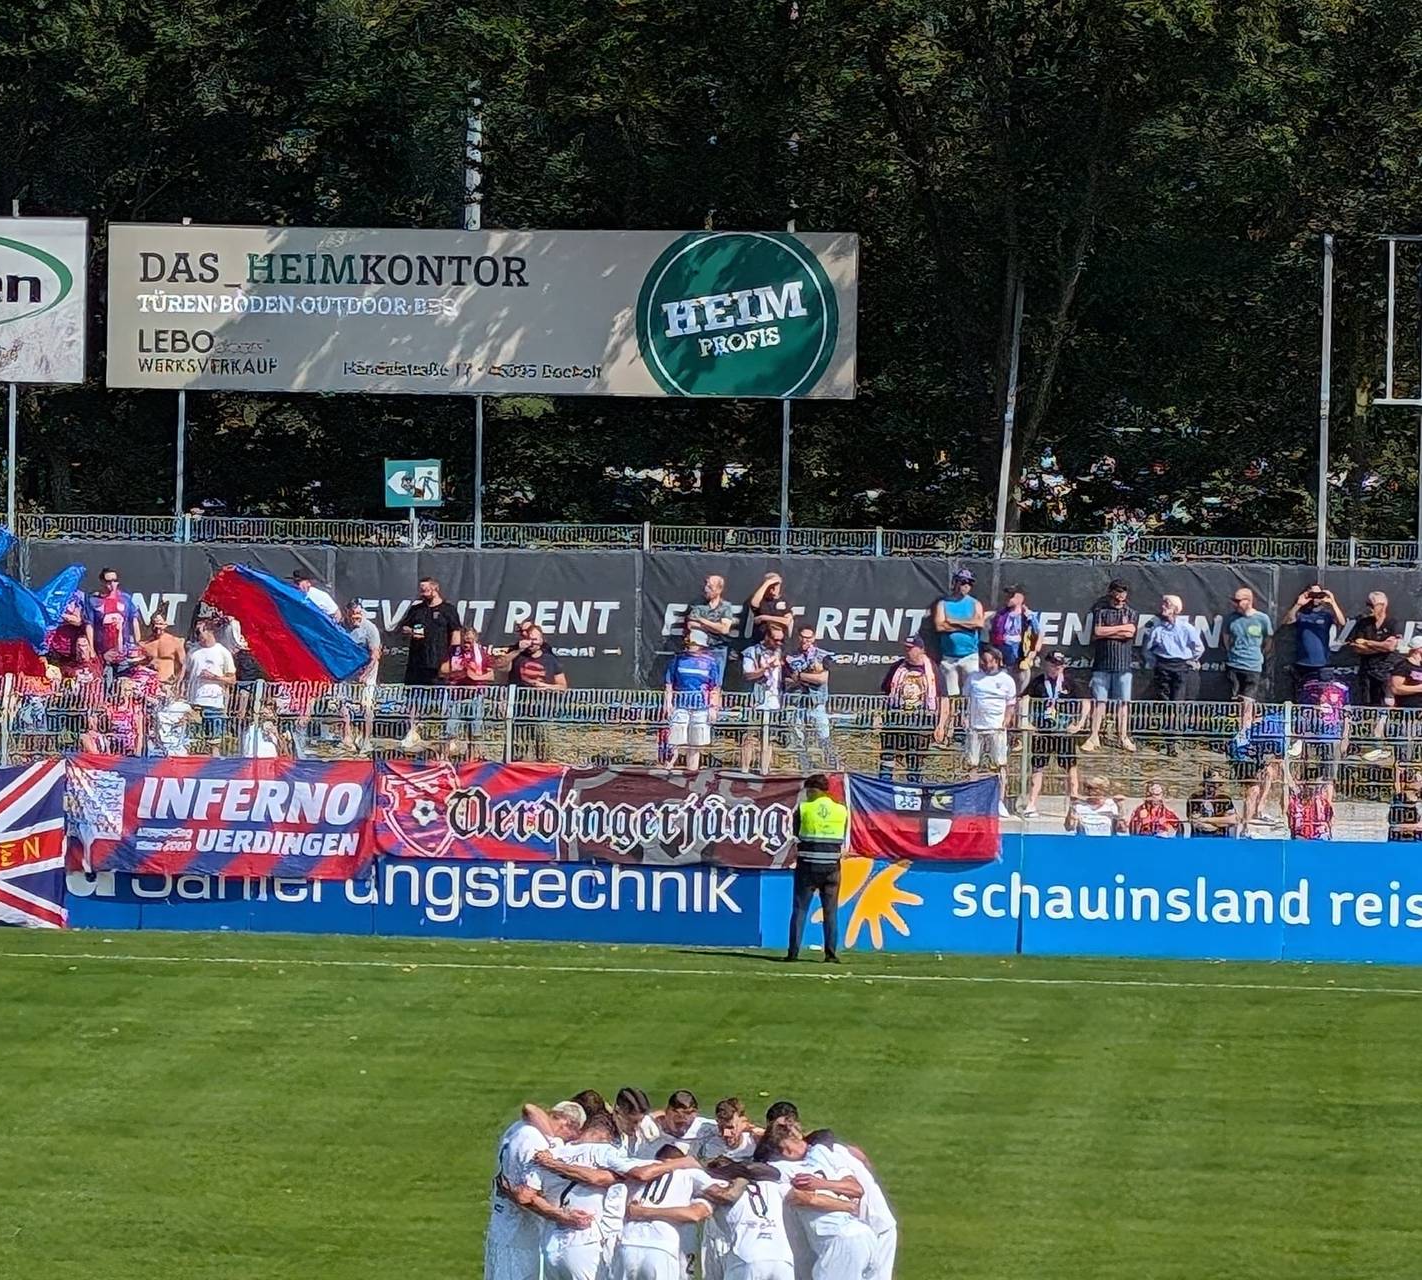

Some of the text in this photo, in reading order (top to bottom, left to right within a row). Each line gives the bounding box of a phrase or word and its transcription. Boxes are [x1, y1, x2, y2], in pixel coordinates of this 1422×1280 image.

[661, 281, 808, 338] HEIM
[138, 329, 214, 353] LEBO
[698, 327, 781, 357] PROFIS
[138, 358, 278, 375] WERKSVERKAUF
[814, 607, 931, 641] RENT
[137, 777, 363, 826] INFERNO
[195, 828, 360, 857] UERDINGEN
[953, 872, 1311, 925] schauinsland
